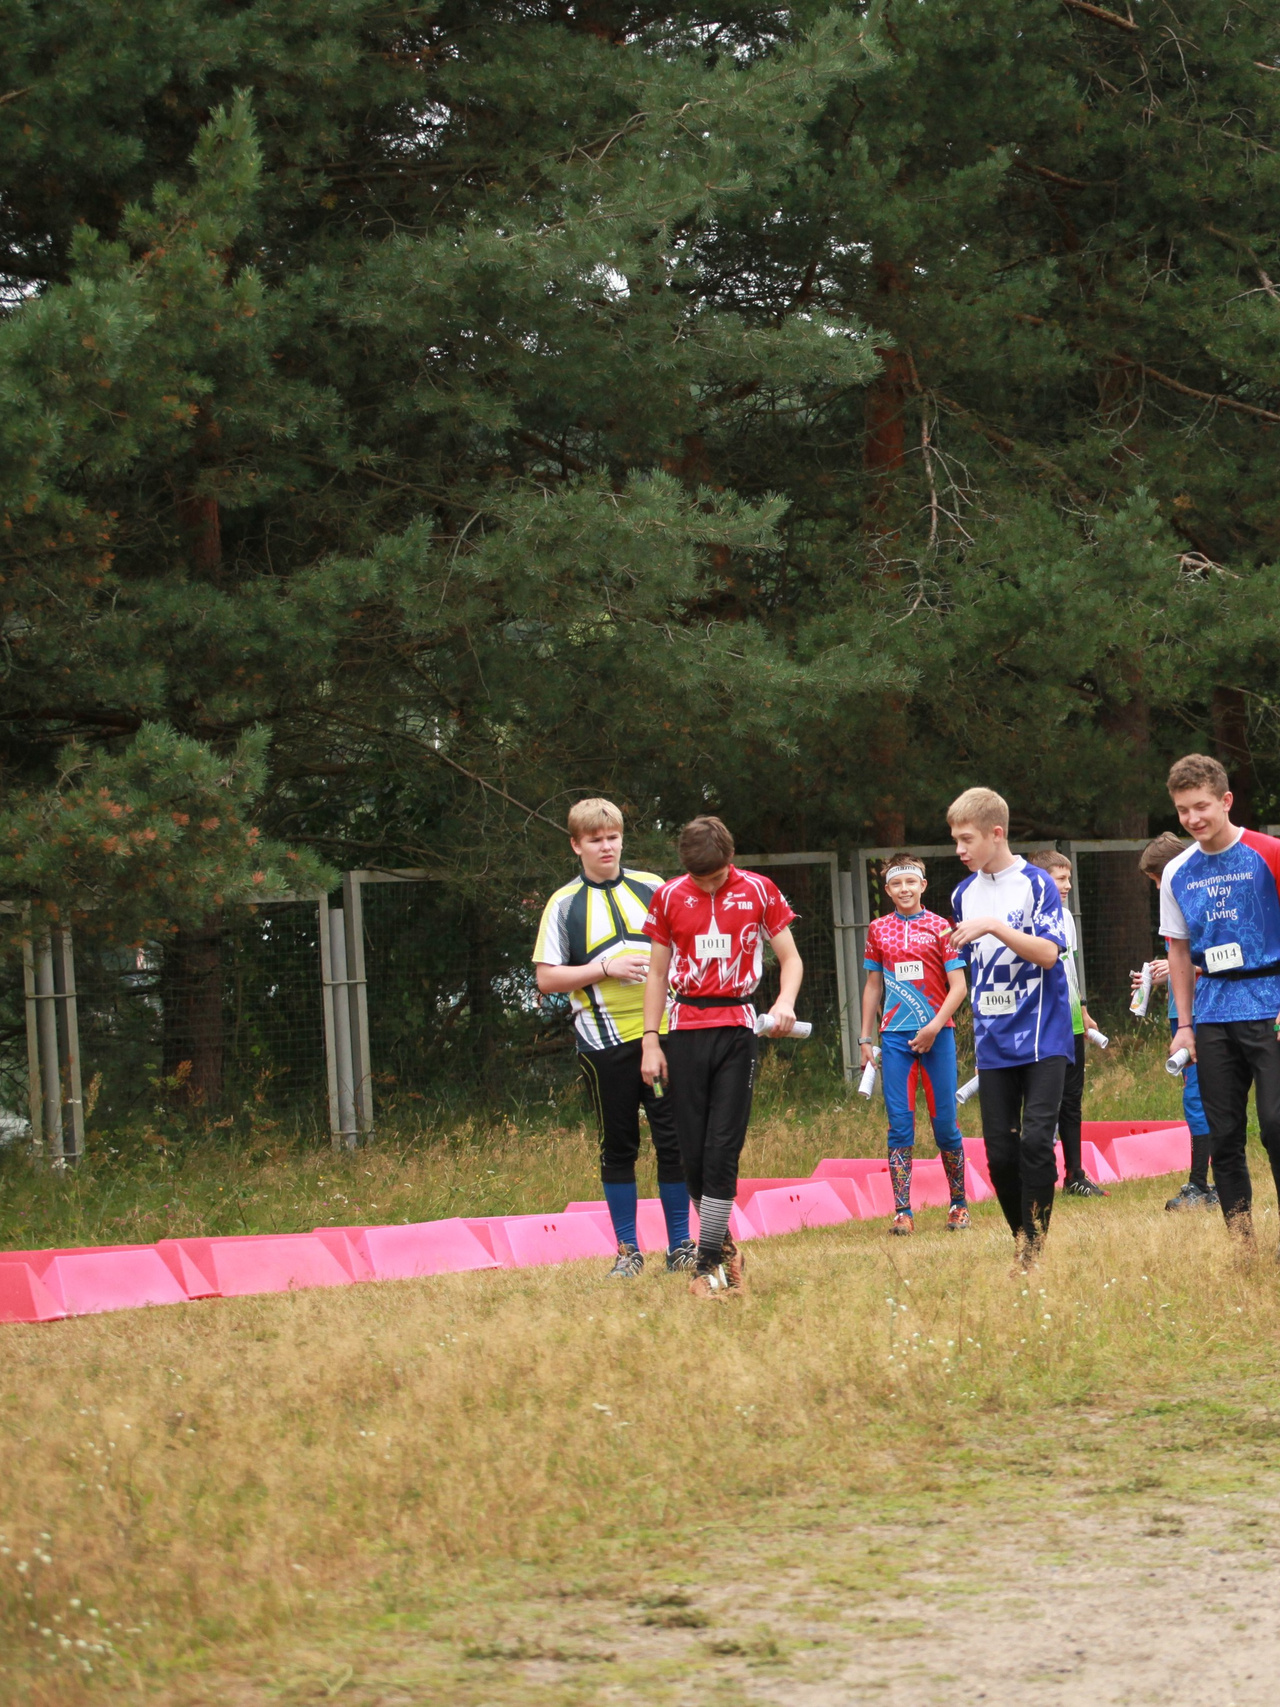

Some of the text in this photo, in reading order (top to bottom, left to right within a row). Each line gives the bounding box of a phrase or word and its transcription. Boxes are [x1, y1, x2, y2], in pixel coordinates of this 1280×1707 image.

[1186, 871, 1254, 890] ОРИЕНТИРОВАНИЕ
[1207, 885, 1232, 898] Way
[1216, 897, 1226, 908] of
[1206, 907, 1238, 922] Living
[701, 938, 726, 949] 1011
[1211, 948, 1237, 962] 1014
[899, 964, 920, 974] 1078
[884, 978, 927, 1023] ОСКОМПАС
[986, 995, 1011, 1005] 1004
